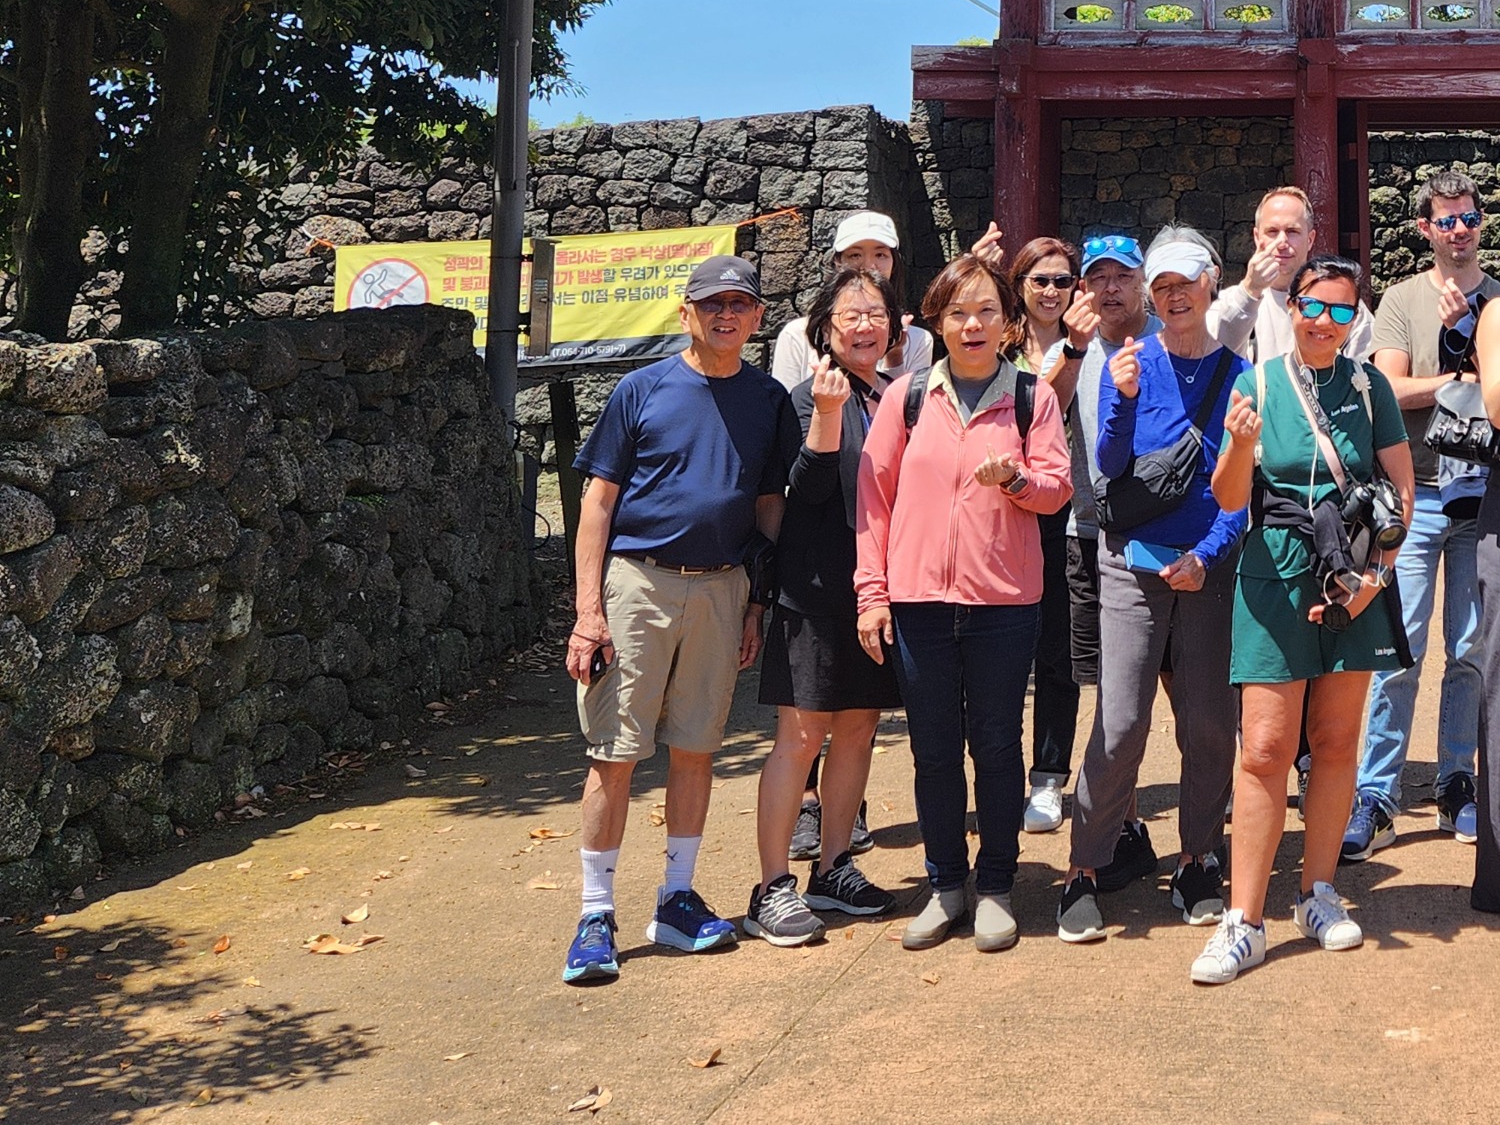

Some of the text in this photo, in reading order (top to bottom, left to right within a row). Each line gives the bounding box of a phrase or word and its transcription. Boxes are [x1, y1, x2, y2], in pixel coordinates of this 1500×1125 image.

[444, 256, 483, 271] 성곽의
[555, 249, 607, 265] 올라서는
[610, 247, 637, 262] 경우
[443, 276, 456, 291] 및
[460, 275, 489, 292] 붕괴
[578, 268, 617, 284] 발생할
[620, 266, 660, 281] 우려가
[475, 295, 488, 311] 및
[581, 288, 608, 304] 이점
[614, 285, 669, 302] 유념하여
